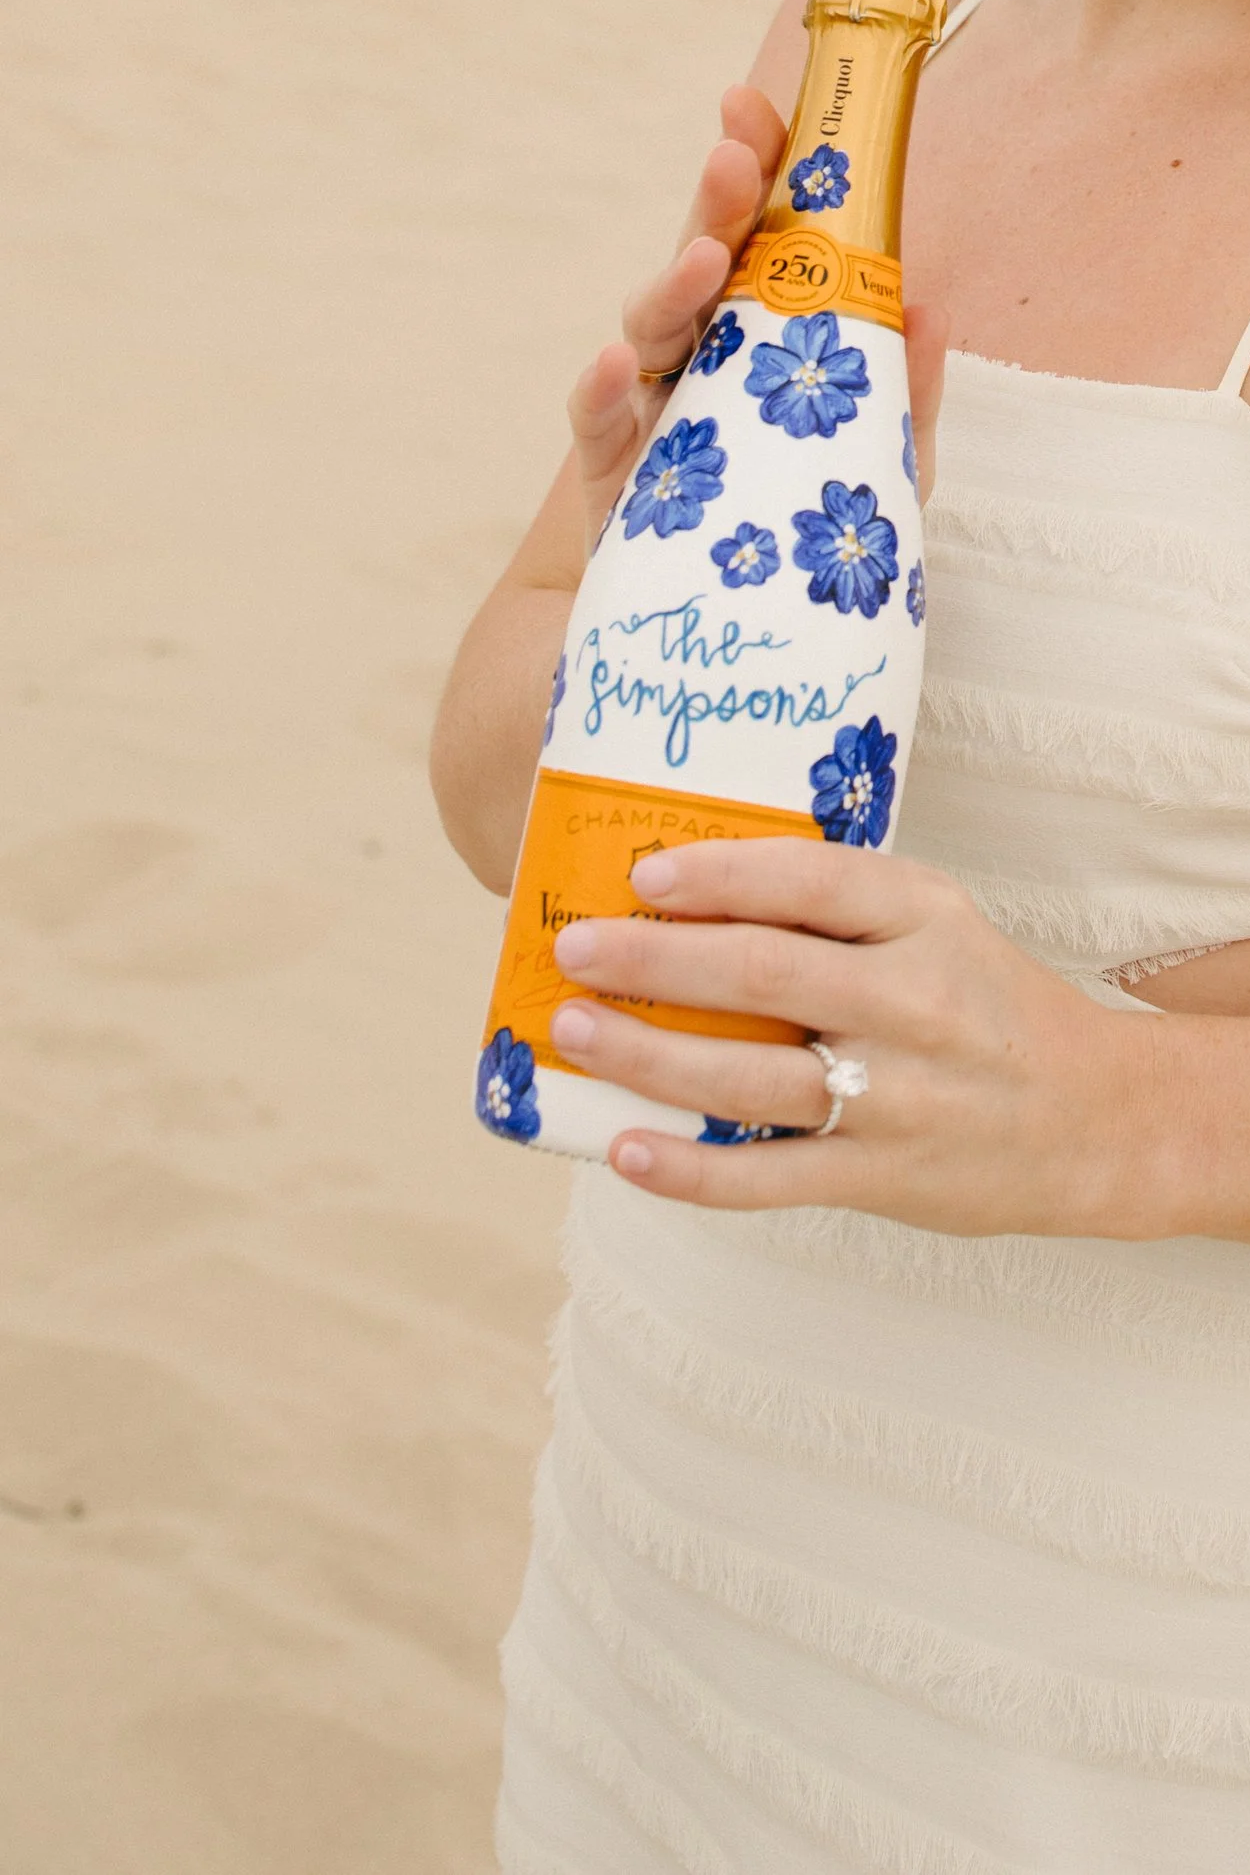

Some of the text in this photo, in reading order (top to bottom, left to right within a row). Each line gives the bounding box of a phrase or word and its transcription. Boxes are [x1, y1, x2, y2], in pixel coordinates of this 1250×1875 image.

[819, 57, 854, 136] Clicquot
[768, 254, 829, 287] 250
[857, 270, 895, 300] Veuve
[566, 809, 741, 840] CHAMPAG
